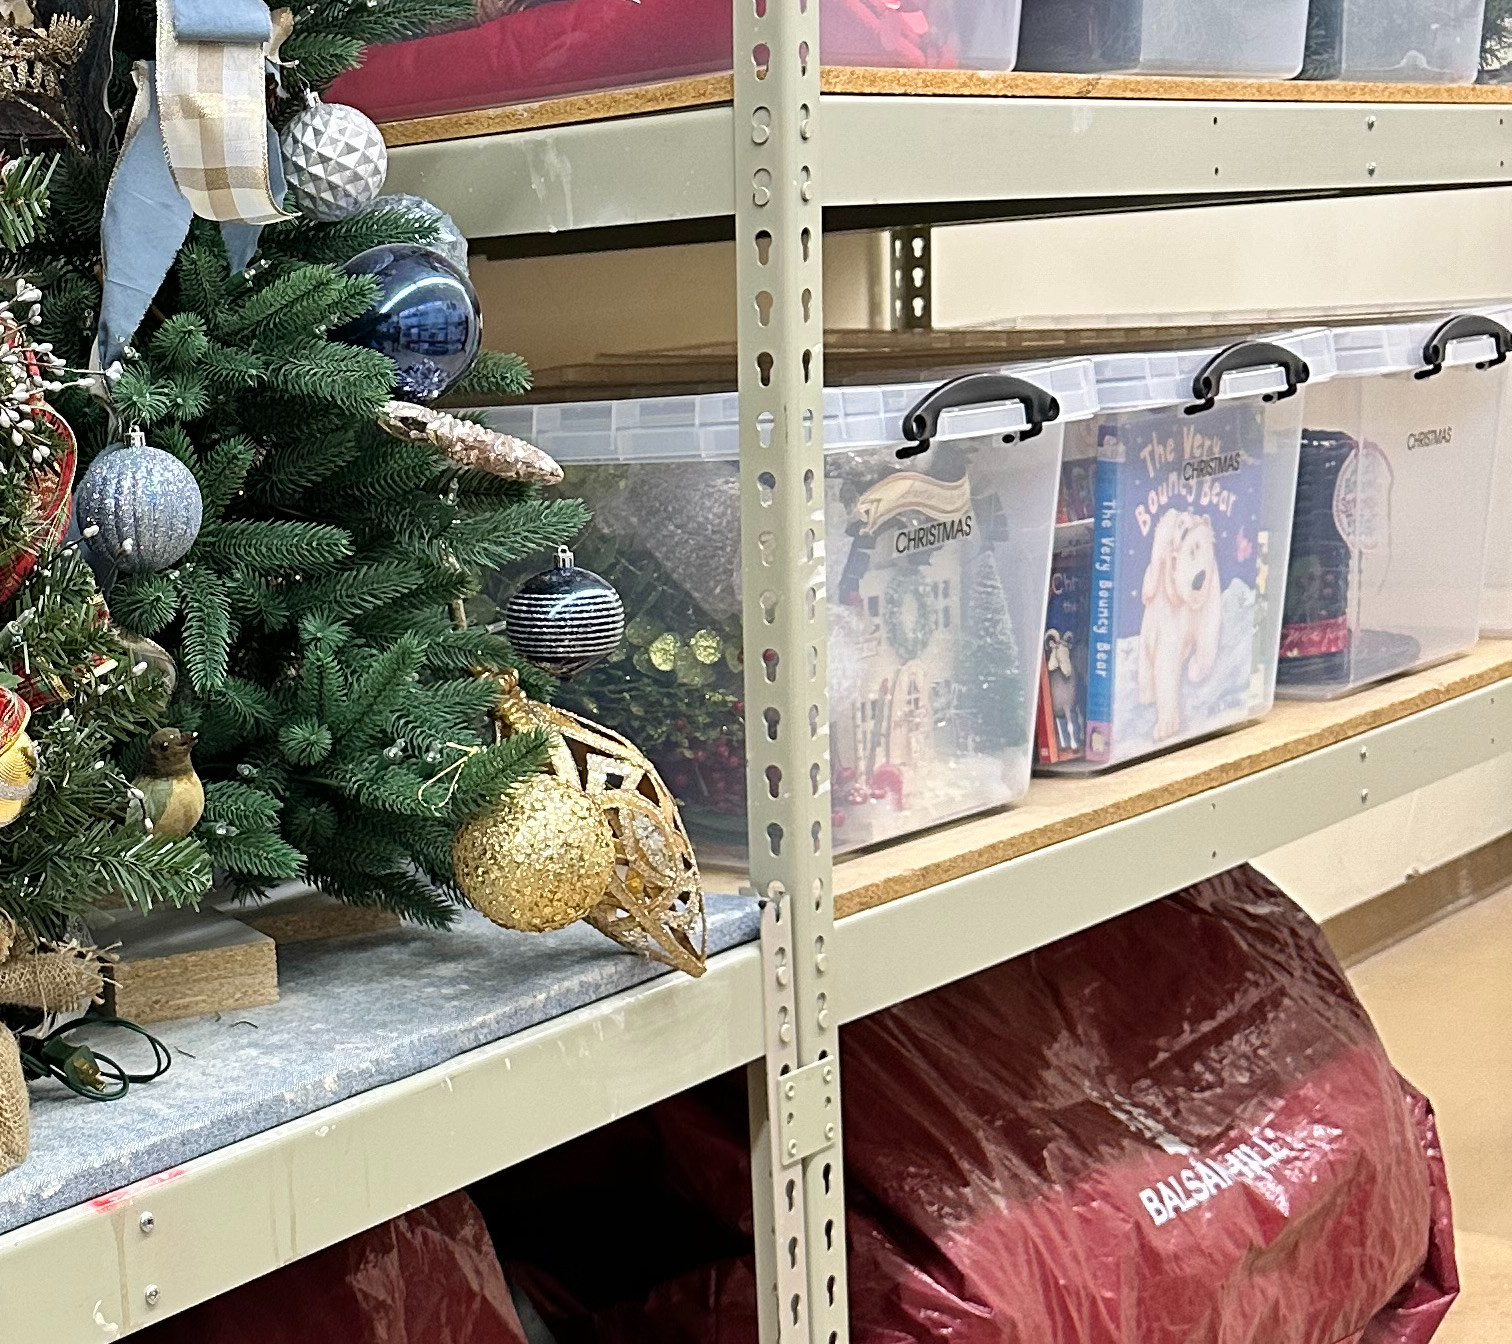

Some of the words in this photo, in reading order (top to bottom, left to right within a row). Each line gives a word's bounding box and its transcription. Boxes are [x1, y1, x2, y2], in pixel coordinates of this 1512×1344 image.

[1140, 432, 1175, 478] The
[1183, 425, 1222, 459] Very
[1407, 426, 1453, 450] CHRISTMAS
[1183, 453, 1240, 482] CHRISTMAS
[1101, 499, 1117, 528] The
[1200, 477, 1238, 517] Bear
[895, 516, 972, 553] CHRISTMAS
[1095, 537, 1115, 572] Very
[1092, 580, 1113, 635] Bouncy
[1096, 644, 1111, 678] Bear
